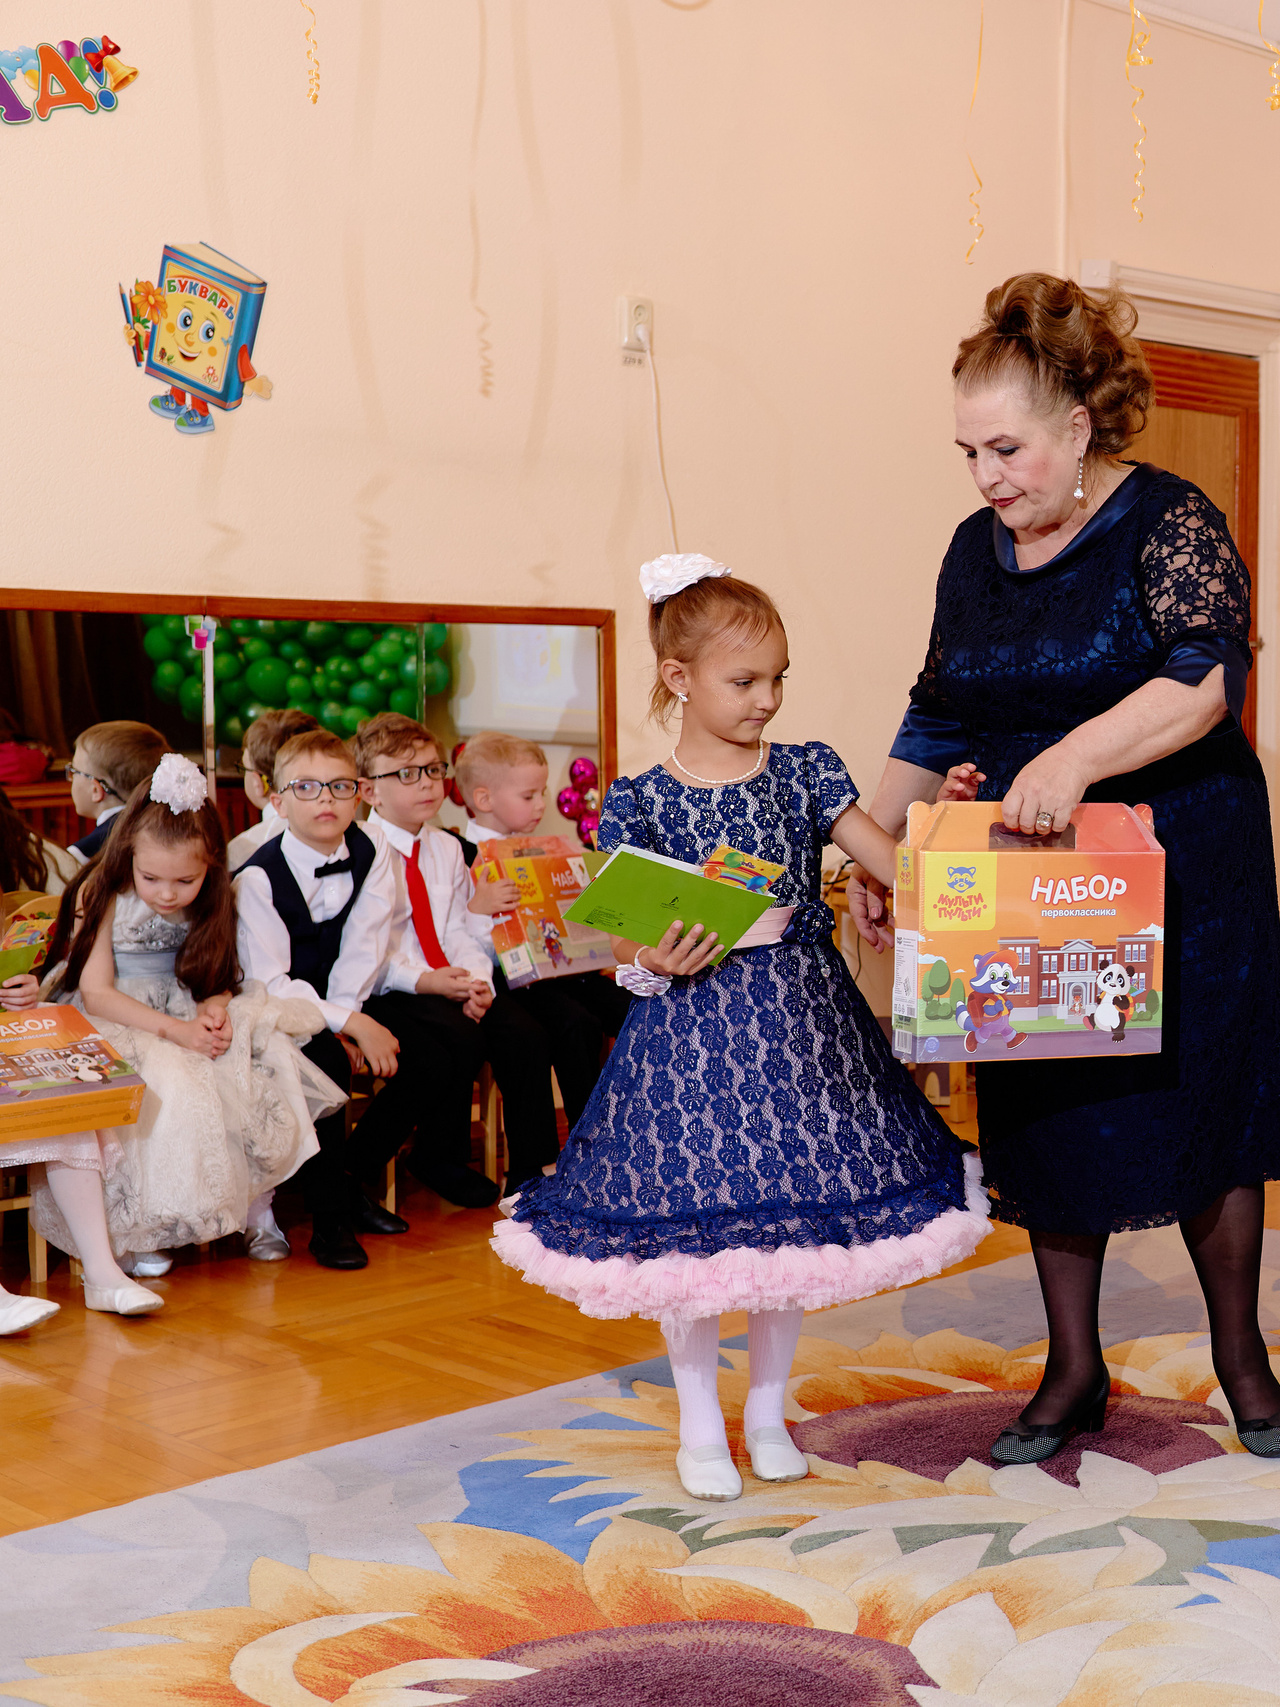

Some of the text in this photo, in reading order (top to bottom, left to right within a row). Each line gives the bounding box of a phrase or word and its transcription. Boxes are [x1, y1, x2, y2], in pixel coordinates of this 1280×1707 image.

[166, 278, 235, 321] БУКВАРЬ
[550, 869, 576, 888] НАБ
[1030, 873, 1128, 905] НАБОР
[937, 892, 985, 909] МУЛЬТИ
[938, 906, 982, 922] ПУЛЬТИ
[1041, 908, 1117, 919] первоклассника
